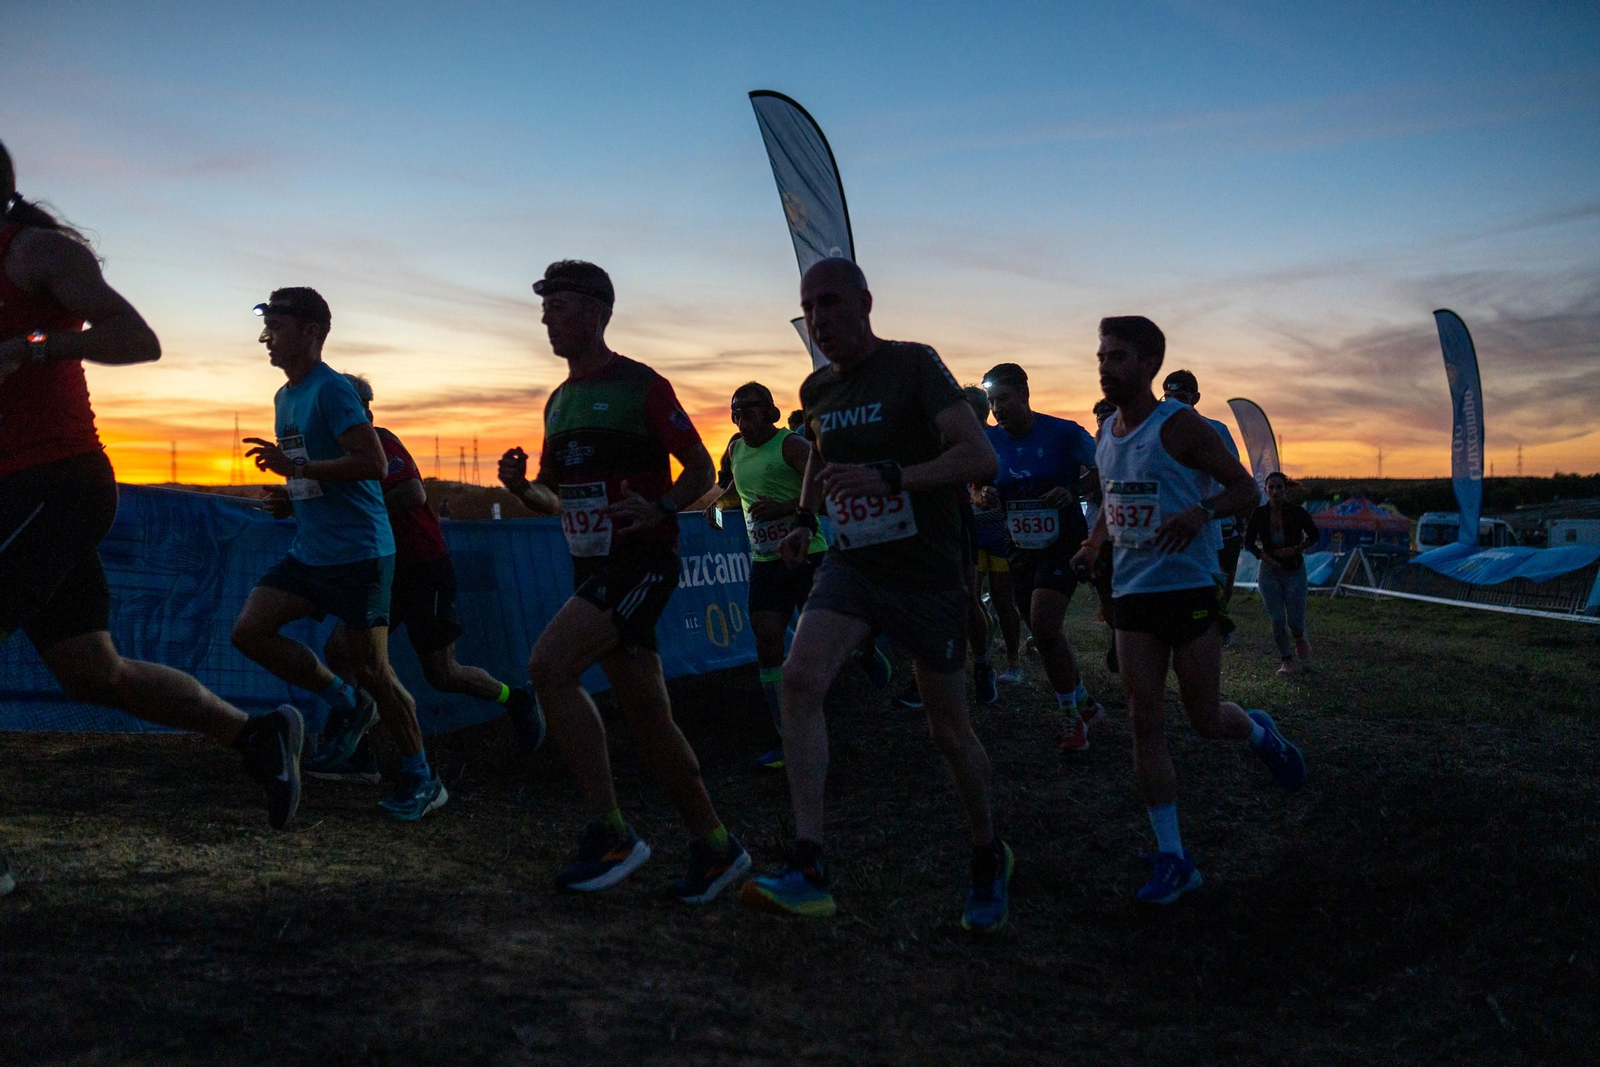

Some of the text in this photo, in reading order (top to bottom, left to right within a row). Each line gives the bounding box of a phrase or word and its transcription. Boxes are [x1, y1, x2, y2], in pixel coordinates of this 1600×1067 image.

[820, 401, 884, 433] ZIWIZ
[833, 493, 904, 525] 3695
[1108, 504, 1155, 527] 3637
[750, 522, 789, 545] 3965
[1012, 516, 1055, 534] 3630
[678, 551, 752, 589] uzcam
